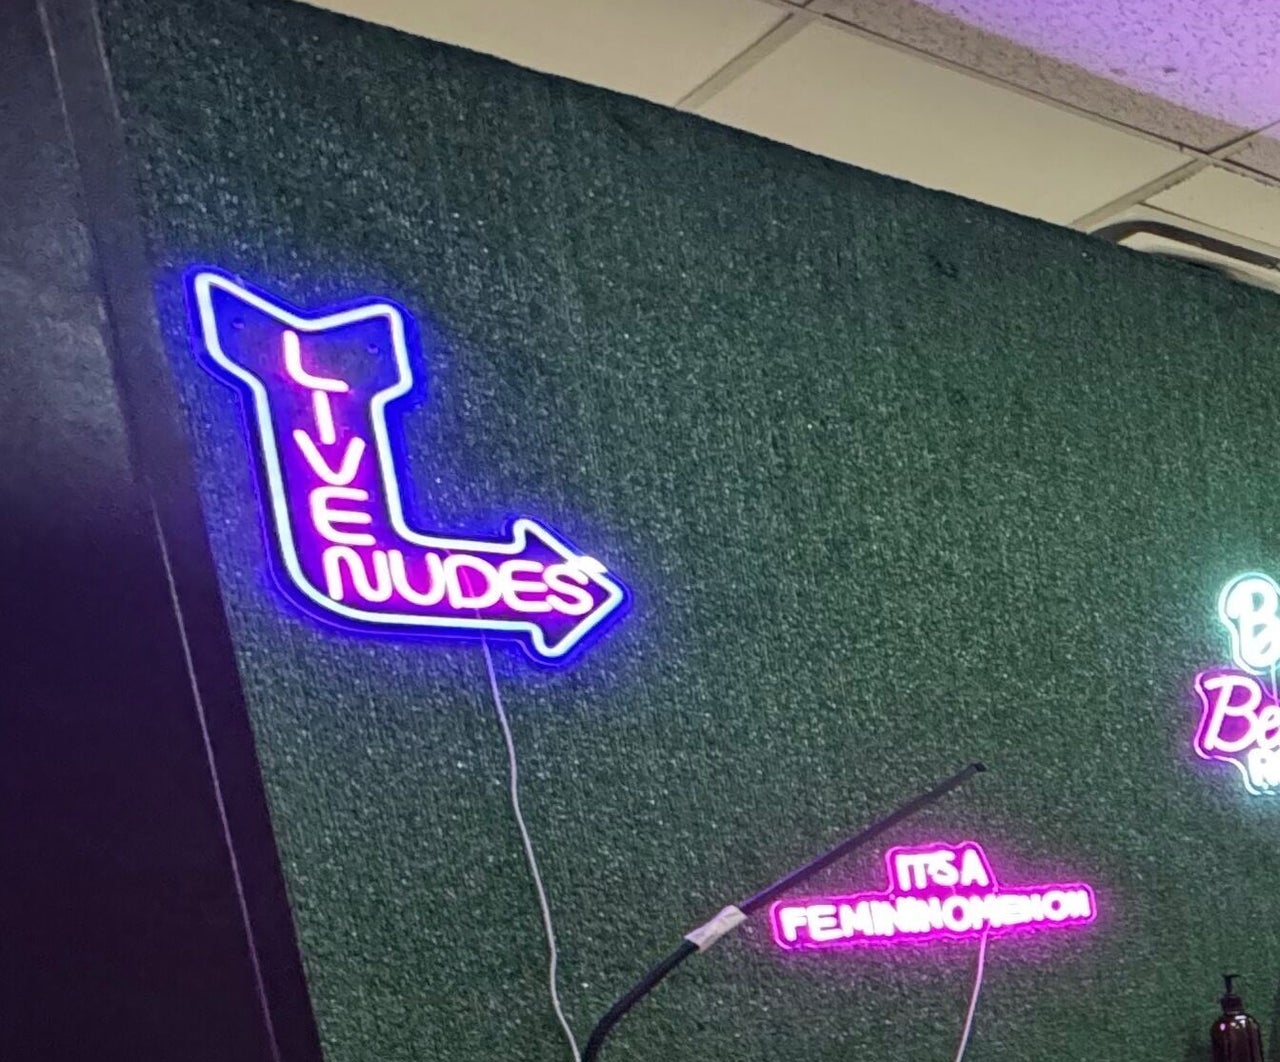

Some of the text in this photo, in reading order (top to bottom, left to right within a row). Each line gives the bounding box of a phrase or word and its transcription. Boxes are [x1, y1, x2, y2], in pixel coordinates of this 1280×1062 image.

[283, 329, 376, 547] LIVE
[321, 544, 596, 617] NUDES
[960, 848, 990, 888] A
